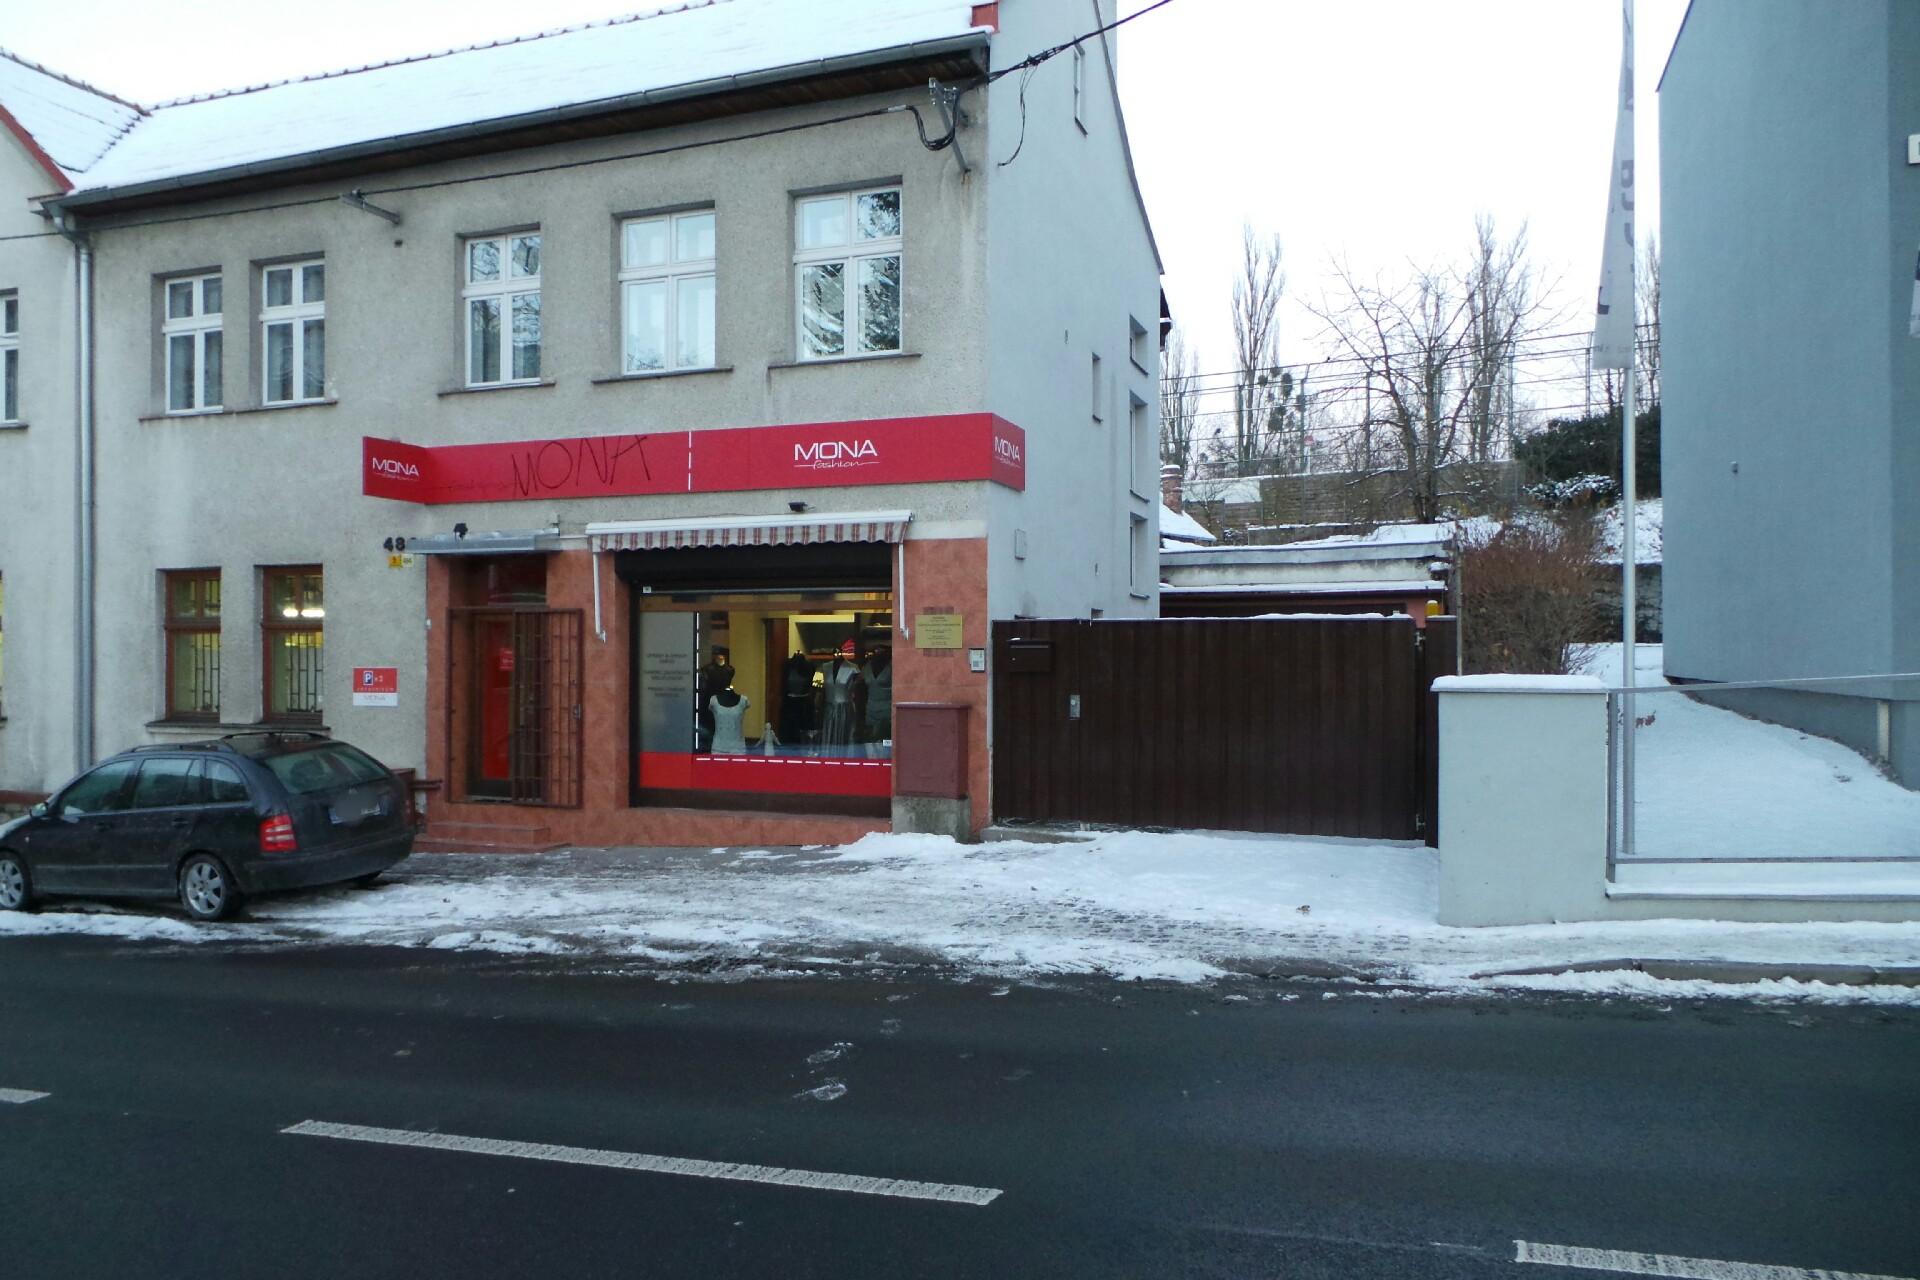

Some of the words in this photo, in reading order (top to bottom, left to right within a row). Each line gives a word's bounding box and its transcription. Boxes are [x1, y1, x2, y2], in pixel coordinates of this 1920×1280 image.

[794, 439, 878, 461] MONA
[994, 436, 1021, 463] MONA
[372, 457, 420, 477] MONA
[511, 434, 651, 497] MONA
[812, 459, 862, 470] fashion
